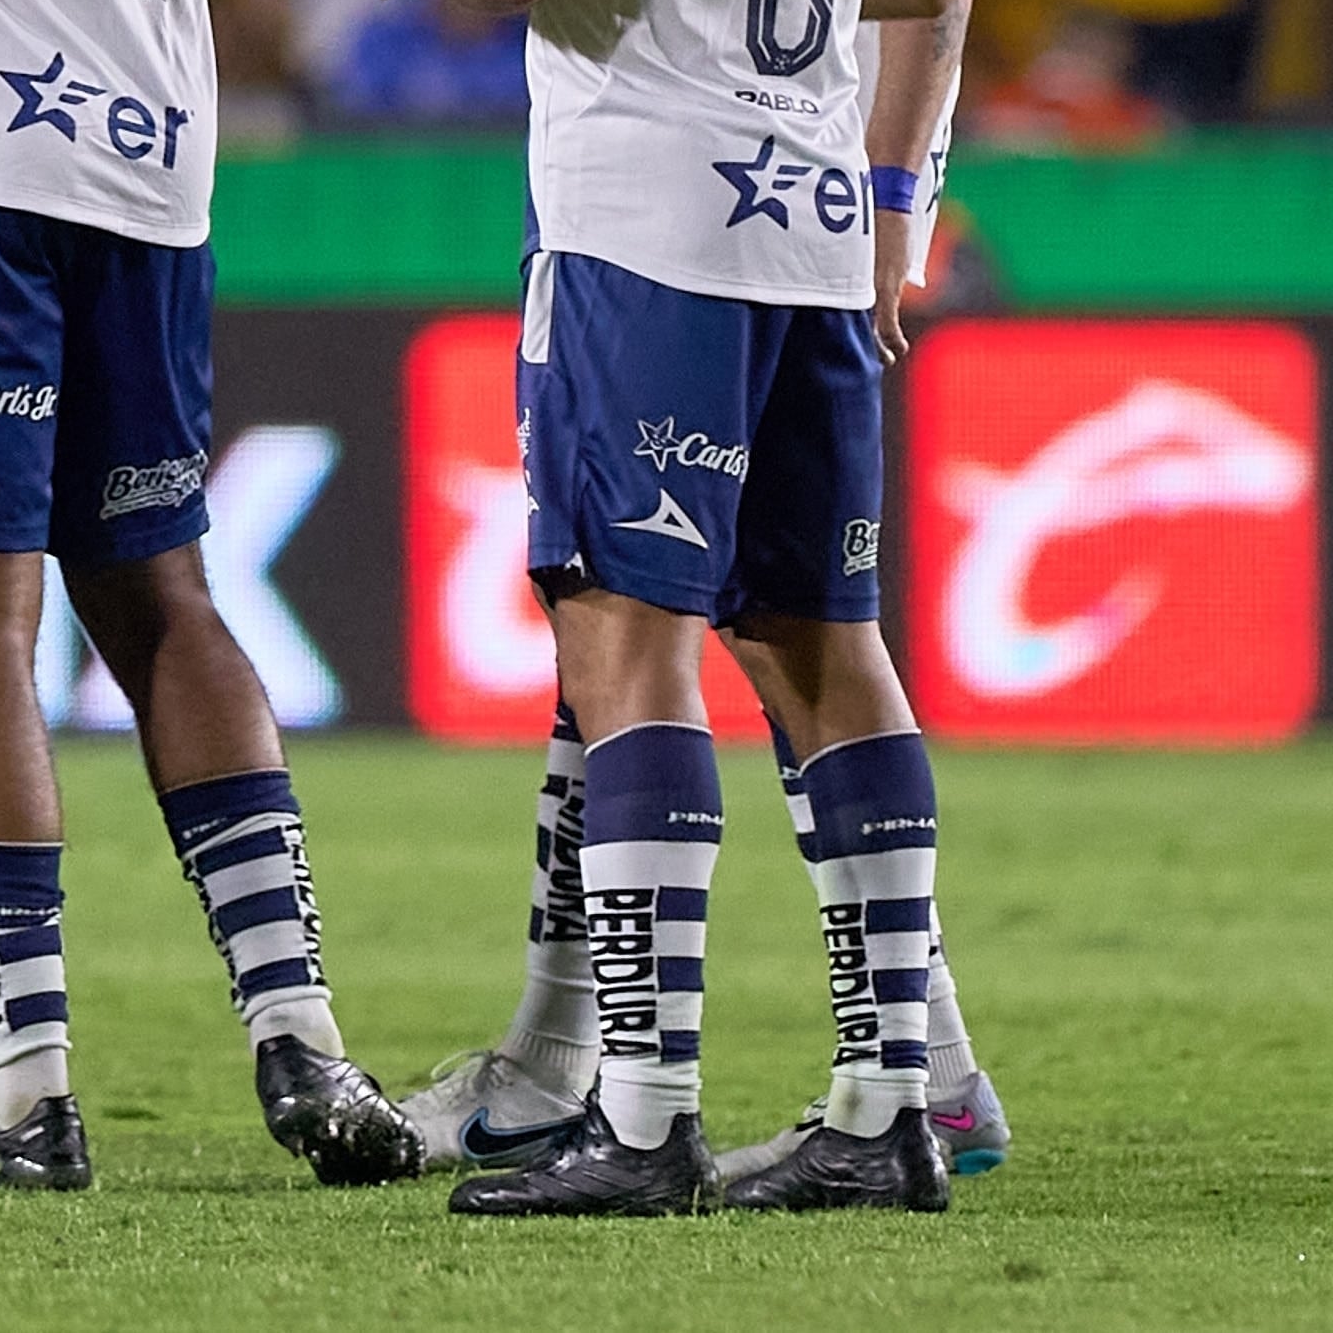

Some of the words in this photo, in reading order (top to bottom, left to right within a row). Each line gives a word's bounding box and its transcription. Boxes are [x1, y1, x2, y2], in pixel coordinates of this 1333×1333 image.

[107, 96, 190, 169] er
[735, 90, 820, 114] PABLO
[584, 888, 660, 1058] PERDURA
[820, 902, 880, 1066] PERDURA
